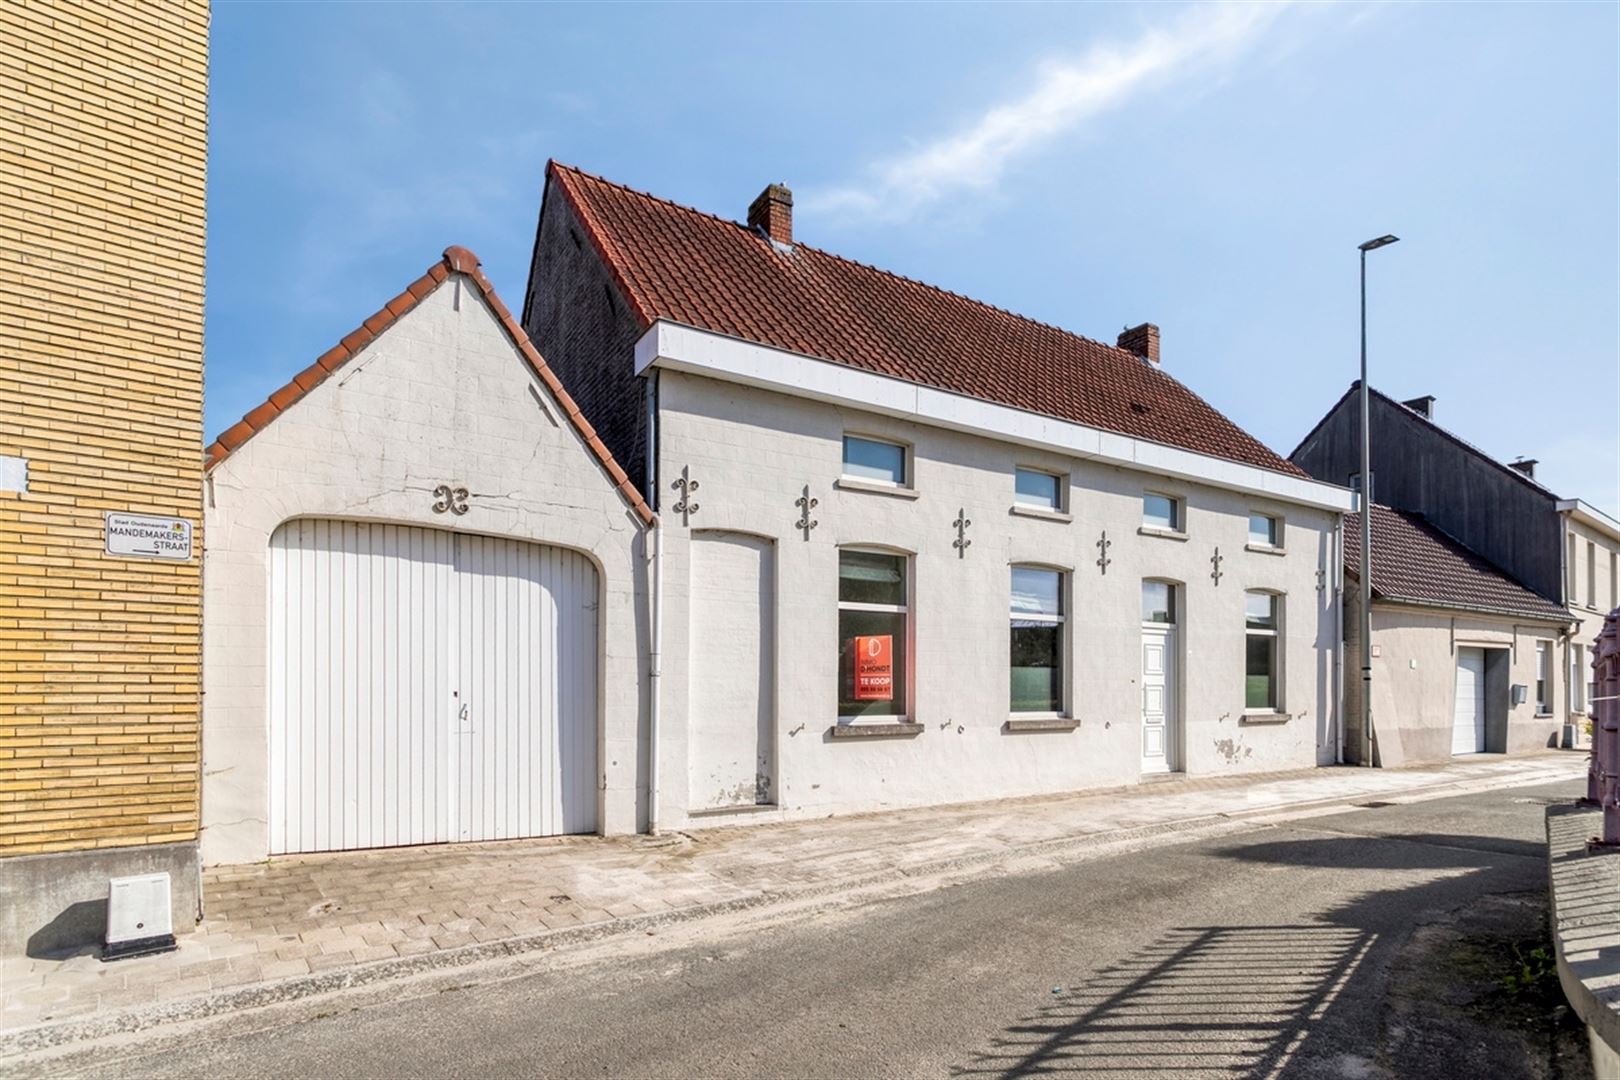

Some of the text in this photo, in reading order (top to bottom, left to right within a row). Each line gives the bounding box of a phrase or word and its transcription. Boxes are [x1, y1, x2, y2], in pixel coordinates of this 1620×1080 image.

[131, 520, 168, 529] Oudenaarde
[110, 527, 188, 541] MANDEMAKERS-
[153, 541, 188, 551] STRAAT
[860, 677, 890, 685] TE KOOP
